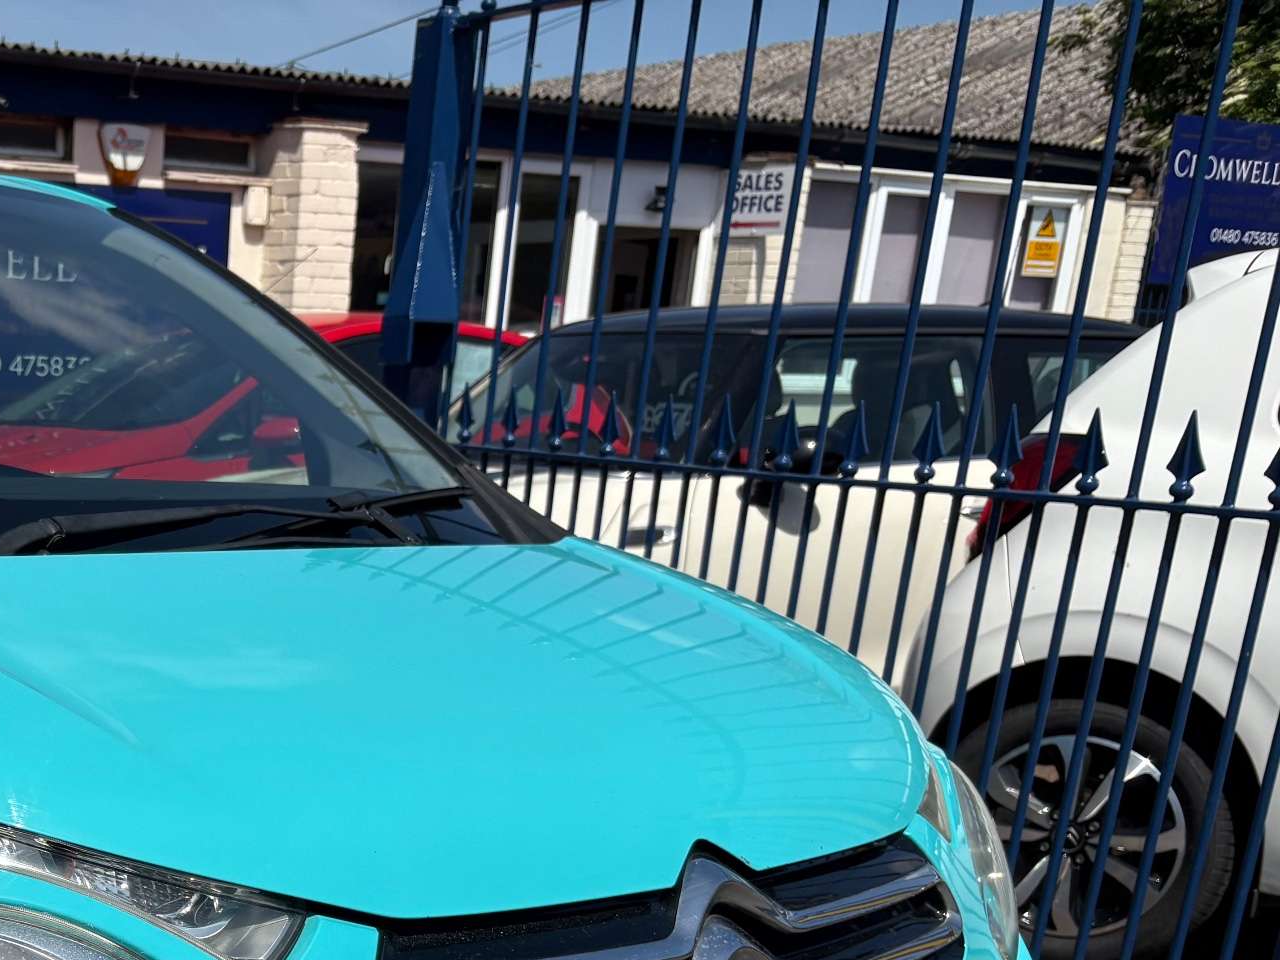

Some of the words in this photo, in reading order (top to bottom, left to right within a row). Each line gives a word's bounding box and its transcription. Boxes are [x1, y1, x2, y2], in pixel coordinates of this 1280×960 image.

[1174, 149, 1280, 185] COMWELL
[1210, 228, 1241, 244] 01480
[1242, 230, 1279, 246] 475836
